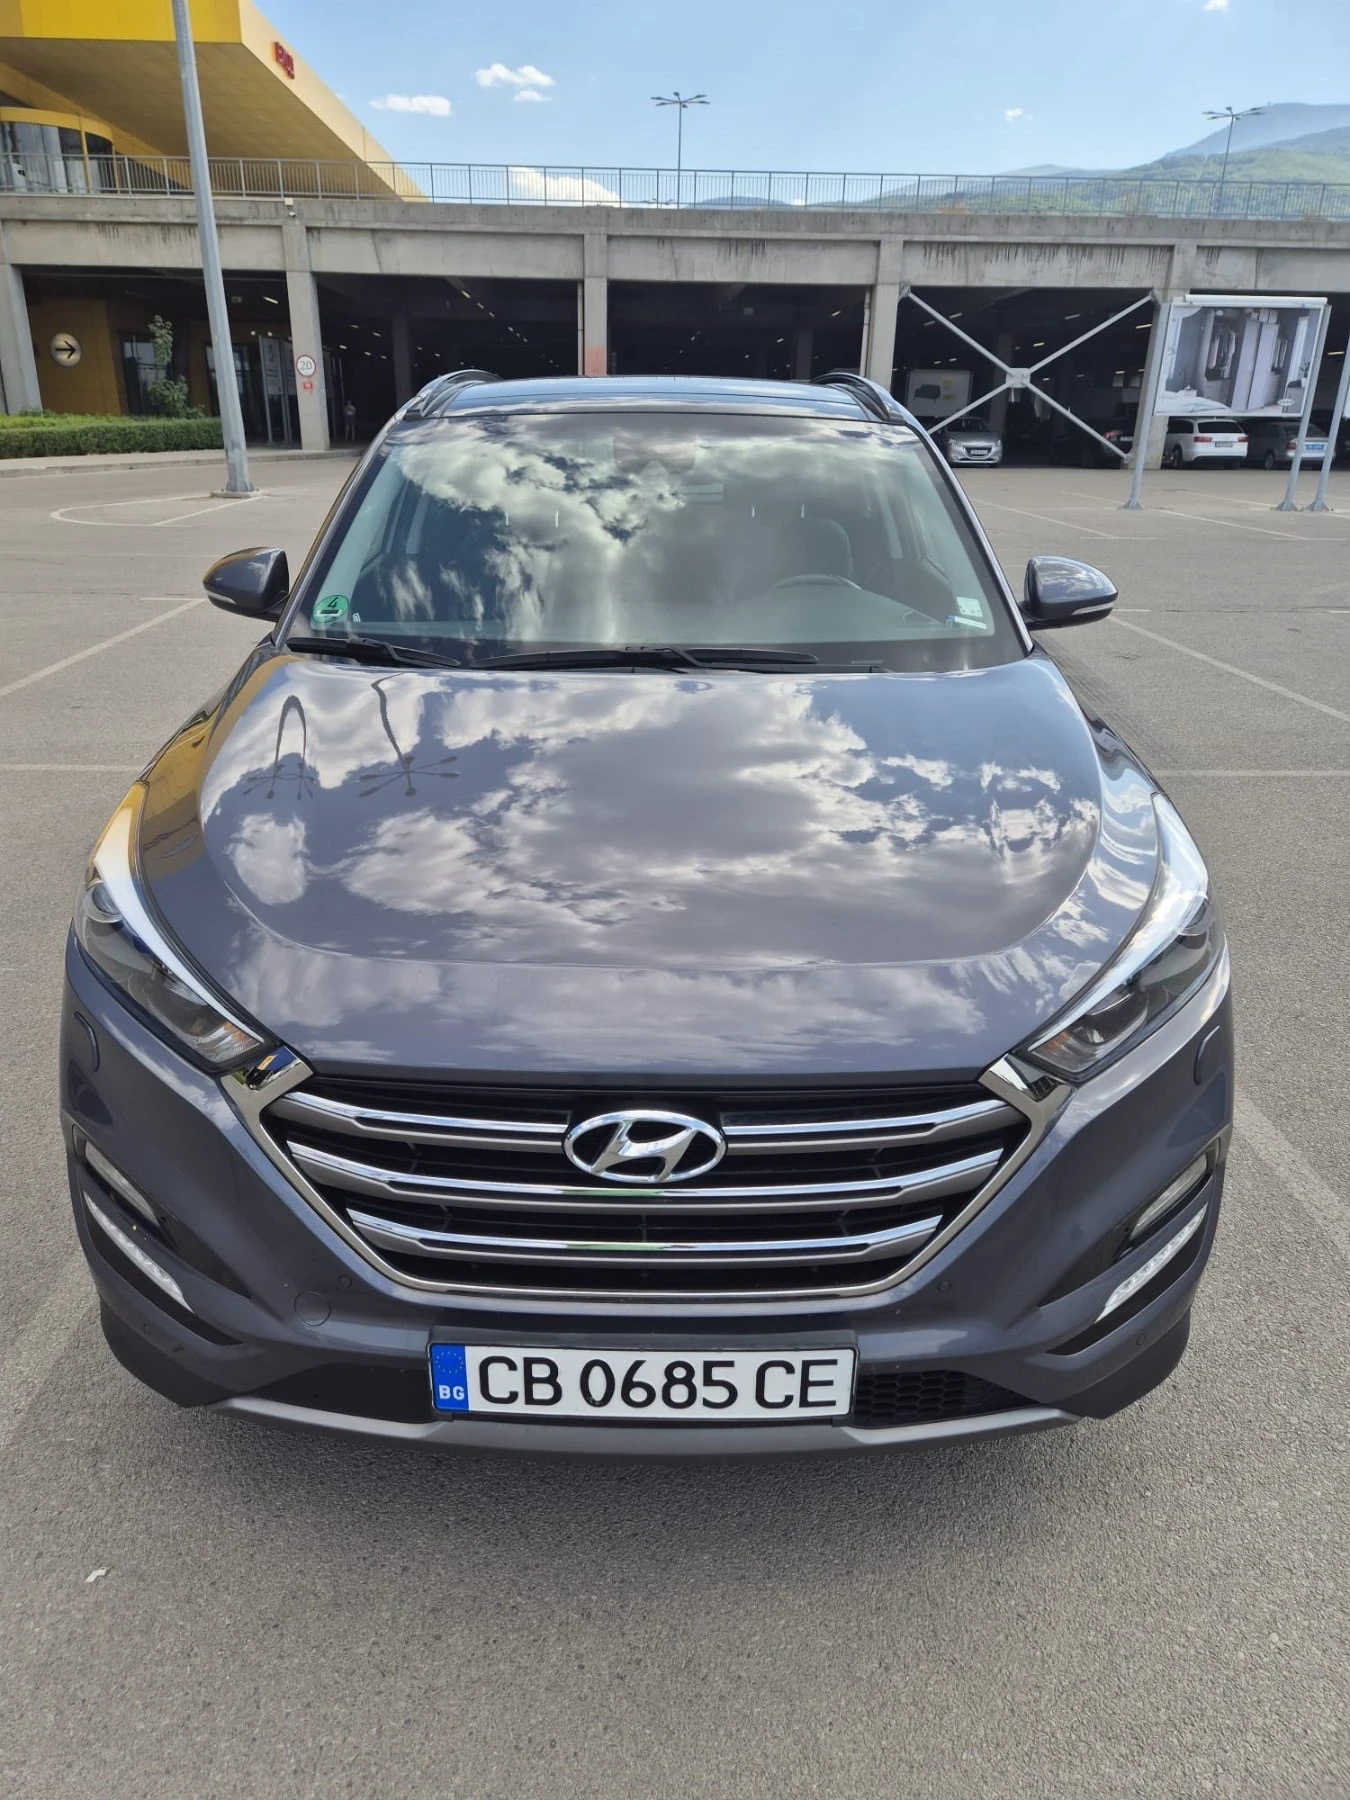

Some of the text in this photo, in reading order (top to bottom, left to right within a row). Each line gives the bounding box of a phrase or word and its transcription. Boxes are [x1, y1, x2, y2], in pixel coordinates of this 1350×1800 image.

[299, 361, 313, 371] 20
[327, 596, 339, 608] 4
[478, 1355, 838, 1409] CB 0685 CE
[438, 1384, 465, 1401] BG
